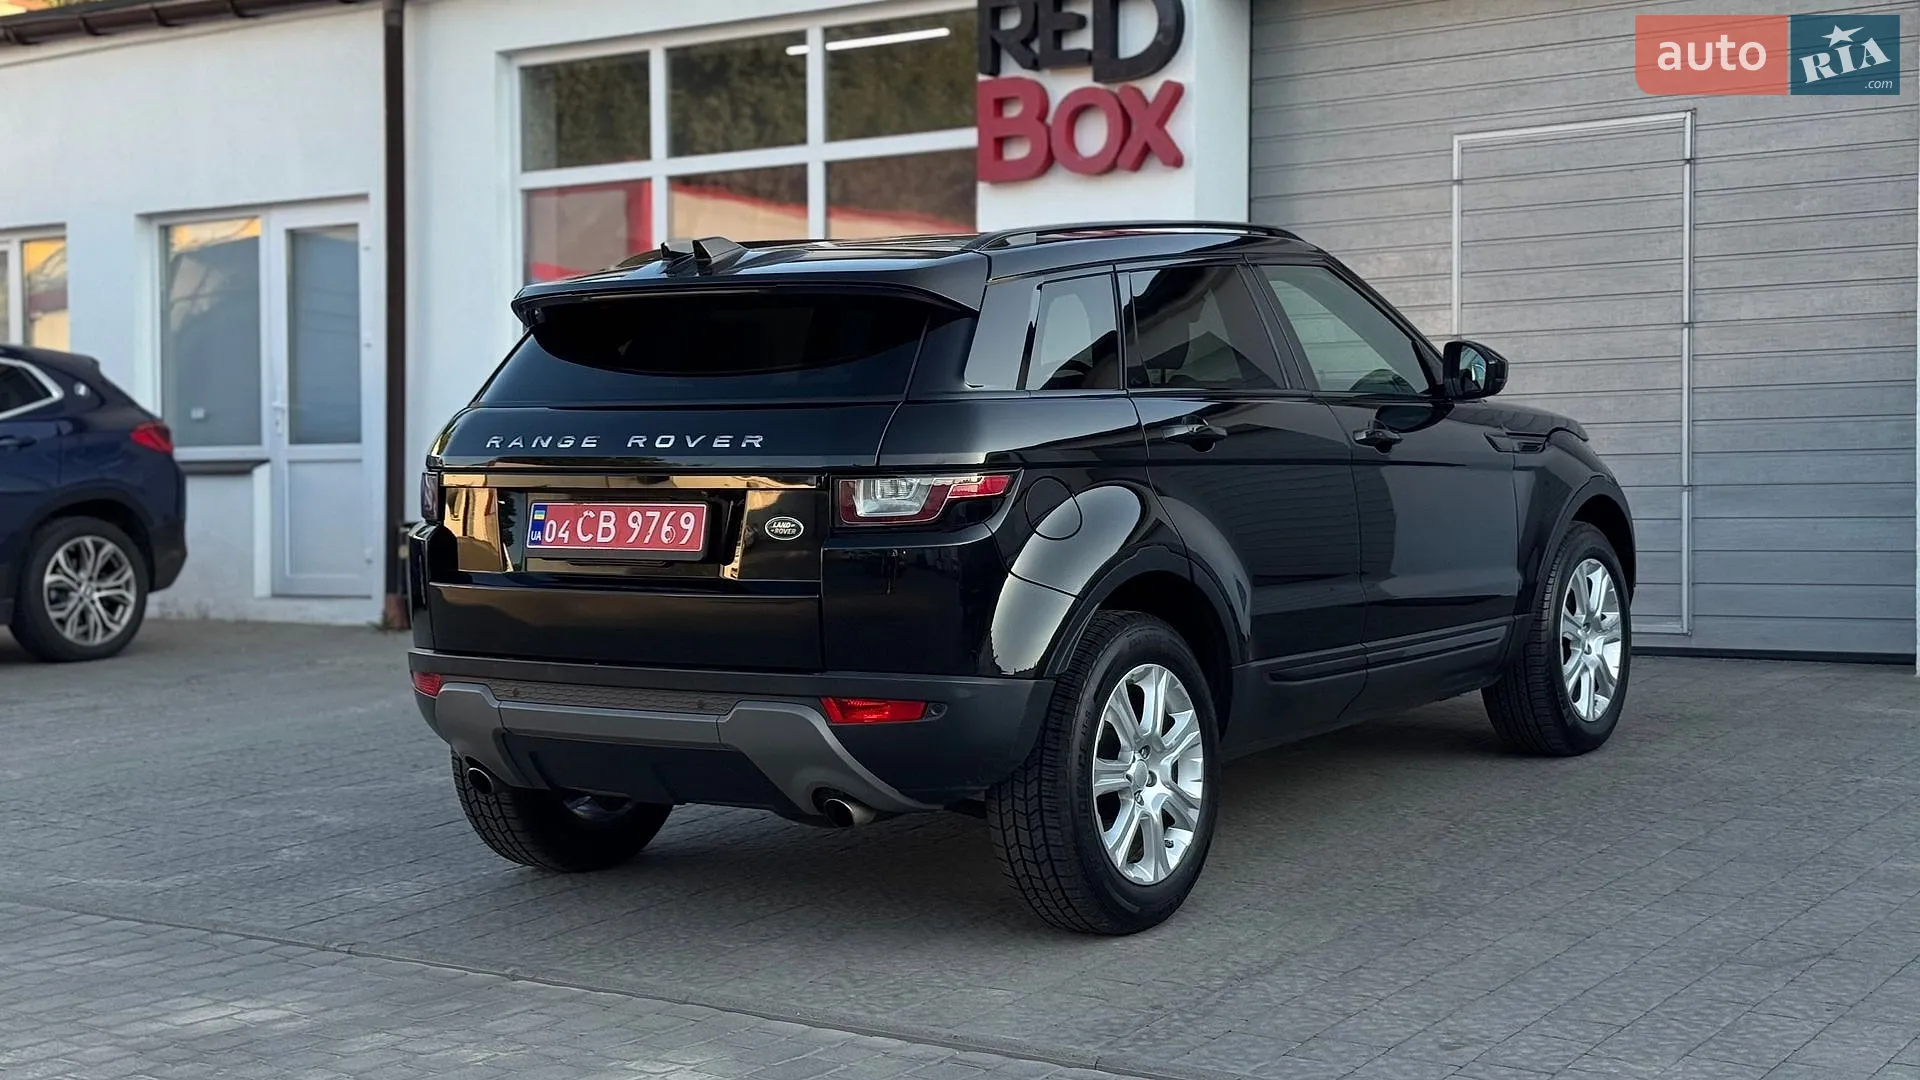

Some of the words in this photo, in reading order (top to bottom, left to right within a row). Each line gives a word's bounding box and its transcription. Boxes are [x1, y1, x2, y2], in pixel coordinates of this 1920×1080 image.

[978, 0, 1185, 83] RED
[977, 76, 1184, 184] BOX
[486, 435, 600, 448] RANGE
[627, 435, 763, 448] ROVER
[530, 530, 542, 541] UA
[544, 519, 570, 544] 04
[576, 510, 616, 543] CB
[626, 510, 696, 545] 9769
